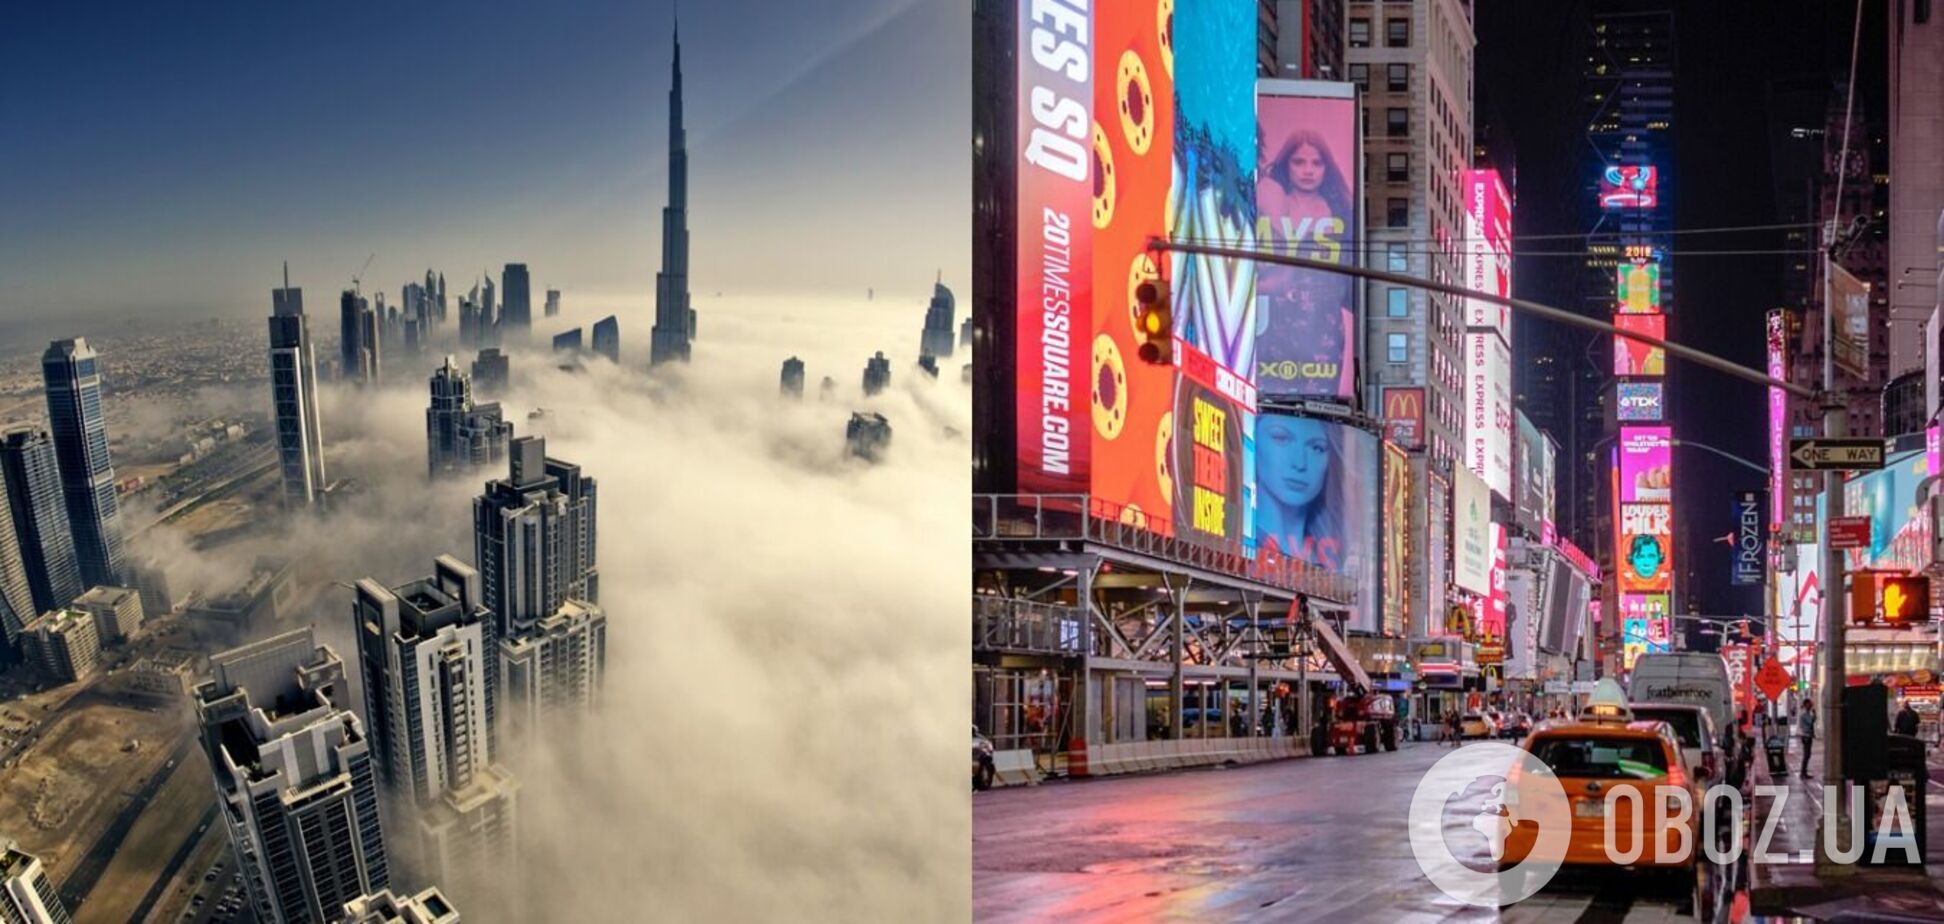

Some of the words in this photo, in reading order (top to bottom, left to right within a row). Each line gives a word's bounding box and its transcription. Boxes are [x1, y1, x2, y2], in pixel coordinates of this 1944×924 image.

[1025, 86, 1088, 182] SQ
[1042, 207, 1070, 475] 20TIMESSQUARE.COM
[1302, 363, 1337, 378] CW
[1474, 374, 1485, 429] EXPRESS
[1629, 397, 1659, 406] TDK
[1194, 397, 1226, 453] SWEET
[1802, 449, 1830, 461] ONE
[1846, 449, 1876, 461] WAY
[1622, 513, 1671, 534] MILK
[1738, 502, 1762, 573] FROZEN
[1646, 685, 1713, 699] featherstone
